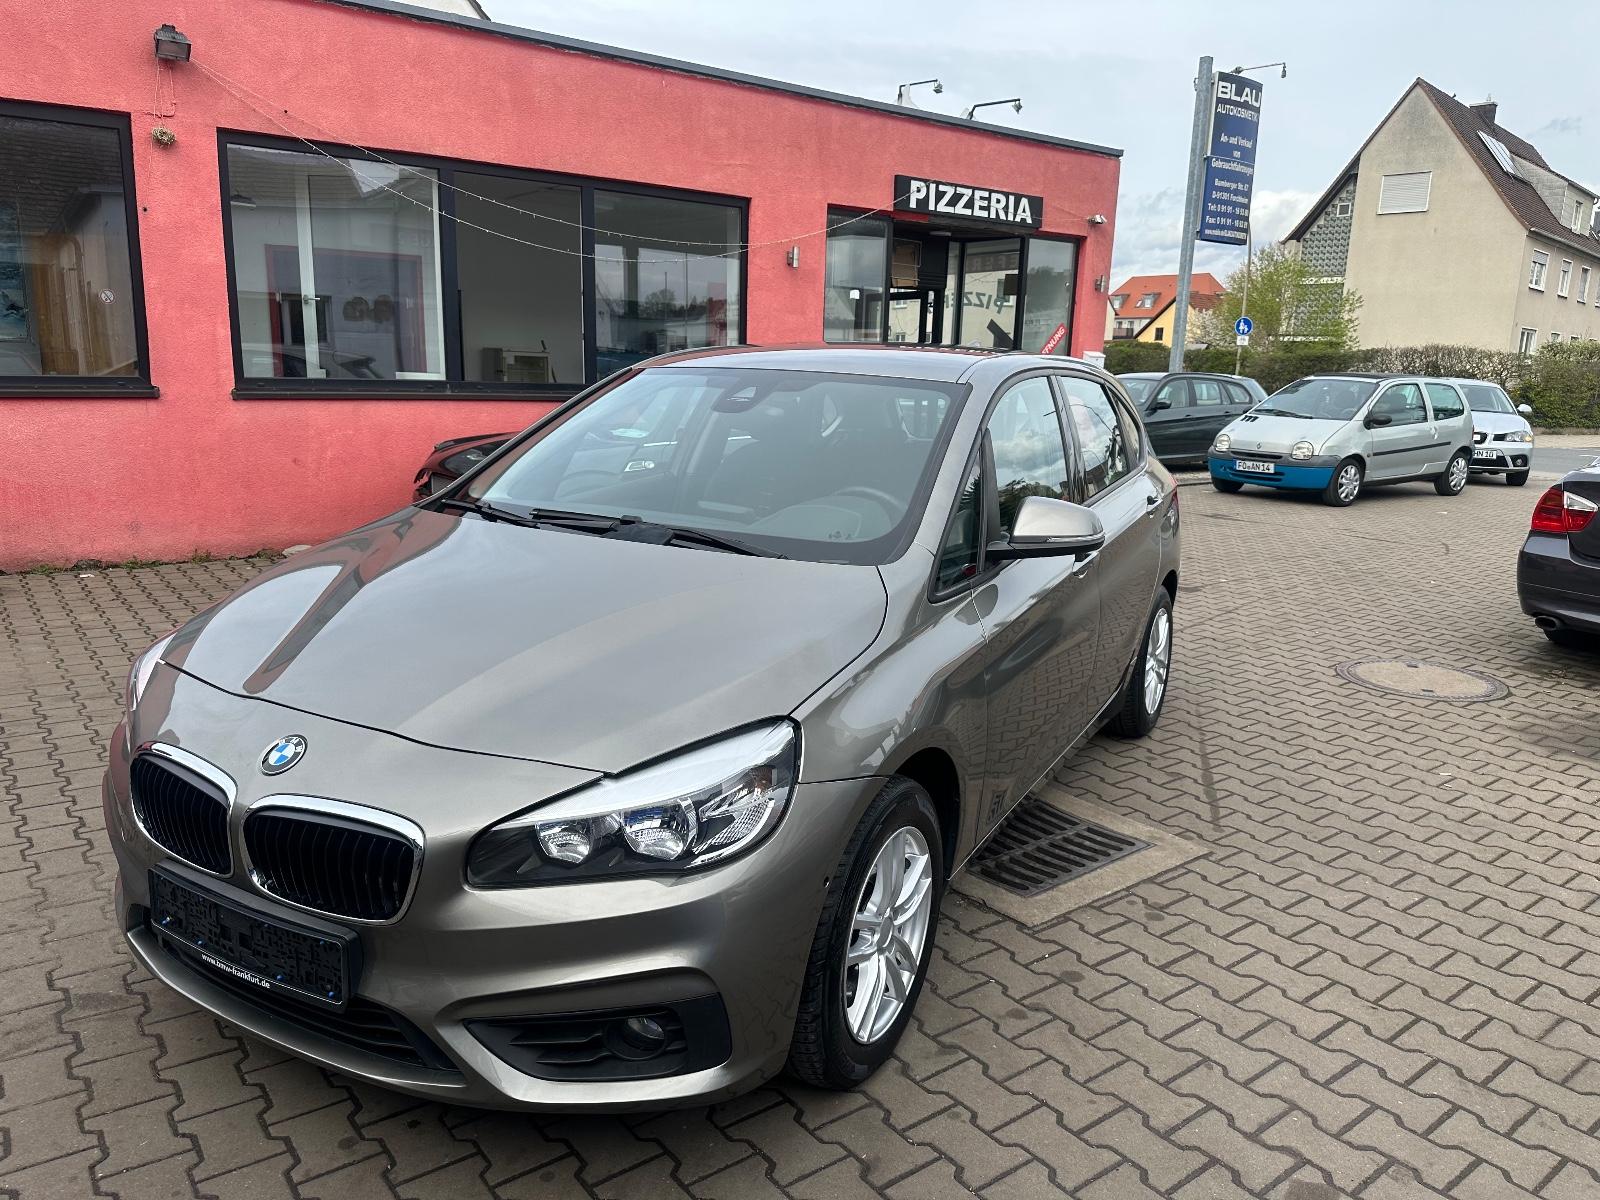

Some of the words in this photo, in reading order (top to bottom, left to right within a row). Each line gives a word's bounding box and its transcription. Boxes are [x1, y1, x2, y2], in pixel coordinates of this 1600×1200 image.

[1217, 81, 1262, 107] BLAU
[909, 180, 1032, 224] PIZZERIA
[1261, 464, 1271, 472] 14
[201, 953, 271, 989] www.bmw-frankfurt.de
